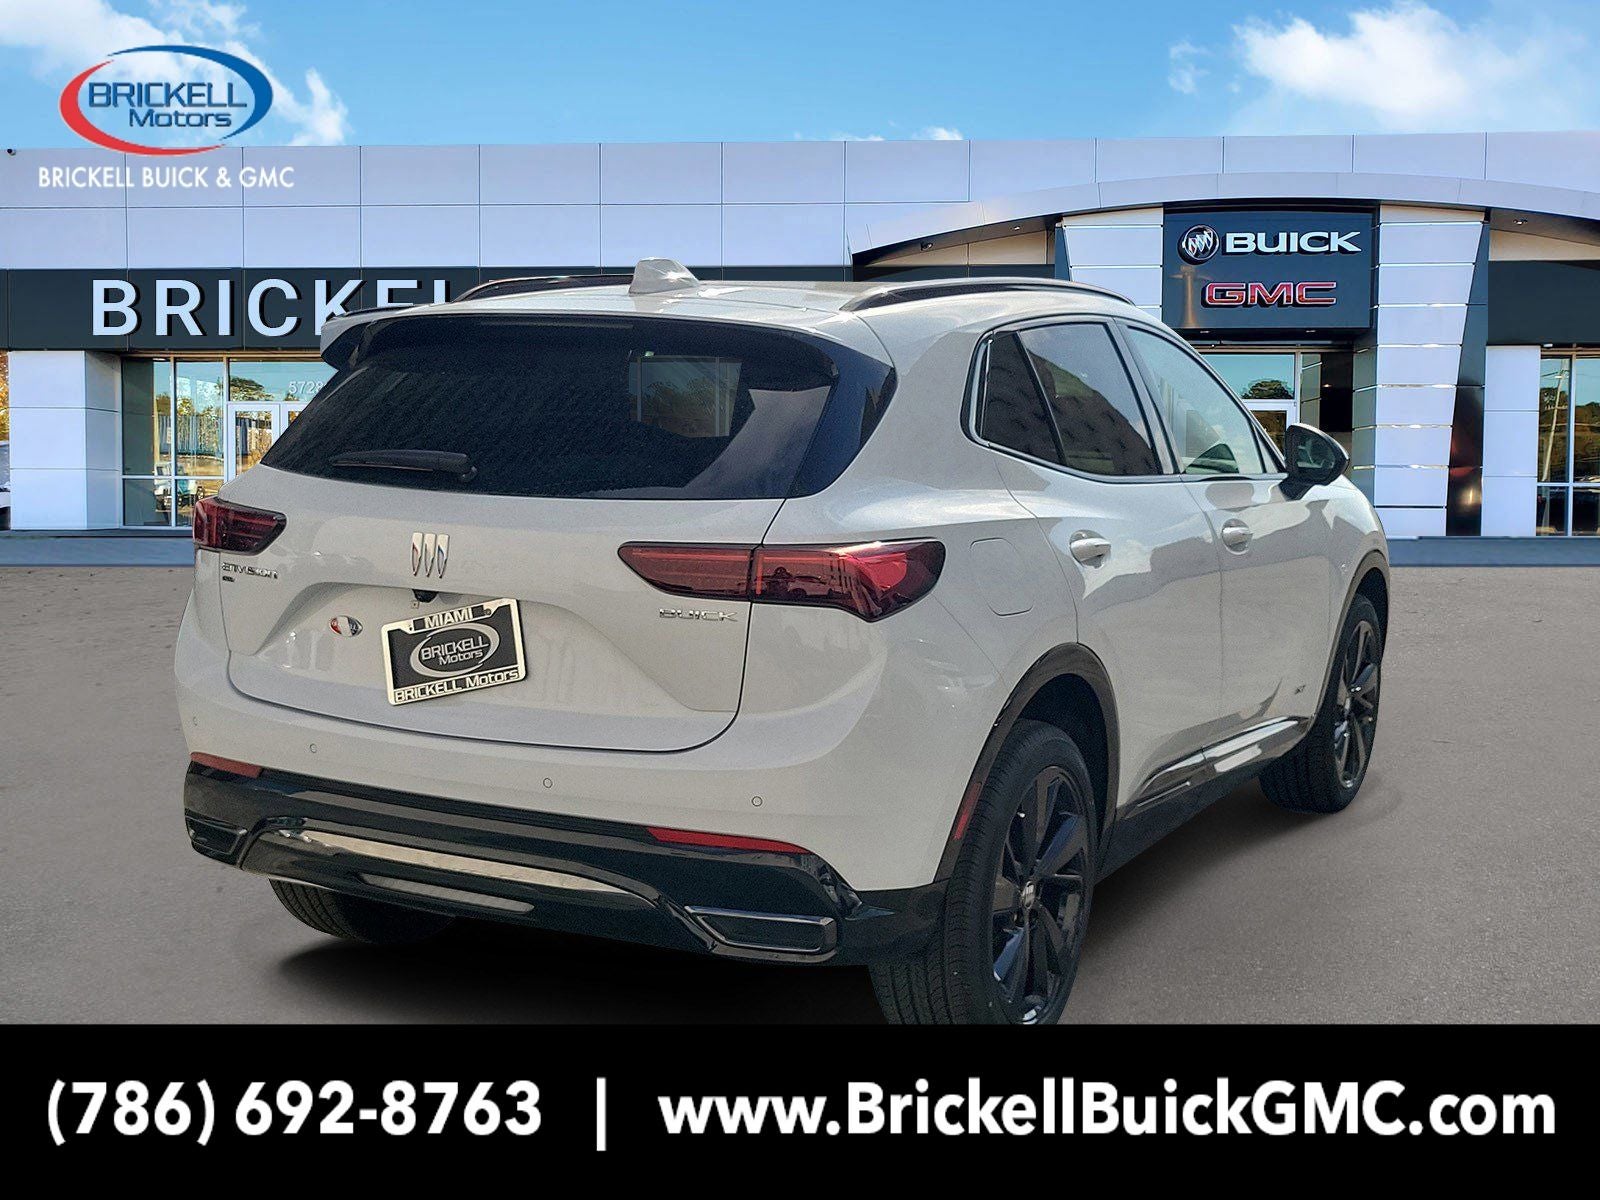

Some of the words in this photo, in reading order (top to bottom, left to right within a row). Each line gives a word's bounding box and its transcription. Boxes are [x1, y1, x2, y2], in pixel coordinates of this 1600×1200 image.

[1225, 231, 1362, 253] BUICK
[1205, 281, 1337, 305] GMC
[424, 607, 474, 629] MIAMI
[659, 607, 739, 622] BUICK
[420, 636, 489, 661] BRICKELL
[438, 649, 484, 666] Motors
[395, 679, 463, 703] BRICKELL
[465, 668, 520, 689] Motors
